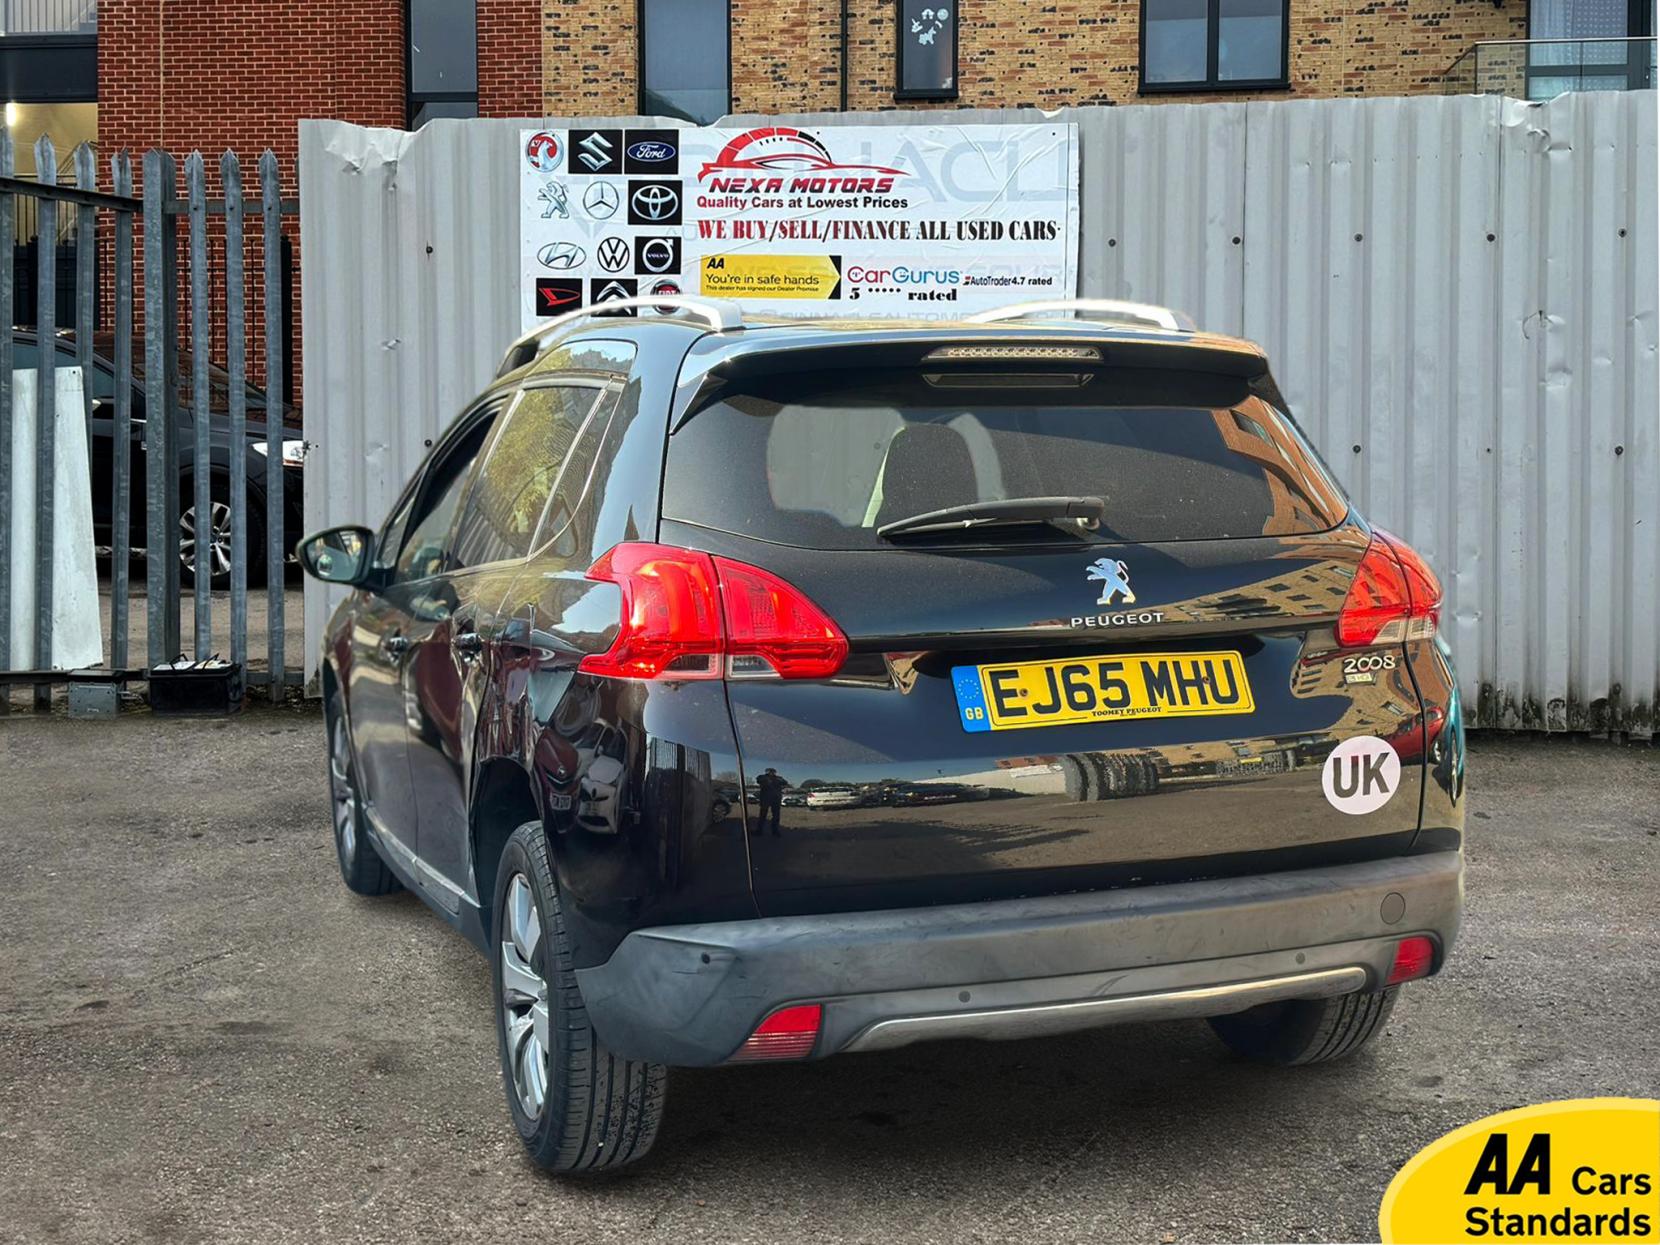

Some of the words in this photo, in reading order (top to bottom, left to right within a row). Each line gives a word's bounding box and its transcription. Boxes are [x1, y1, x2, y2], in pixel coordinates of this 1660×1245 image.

[636, 144, 666, 158] Ford
[709, 178, 784, 193] NEXA
[789, 178, 895, 193] MOTORS
[697, 196, 747, 210] Quality
[752, 197, 784, 208] Cars
[789, 198, 803, 208] at
[807, 197, 859, 208] Lowest
[863, 196, 909, 208] Prices
[697, 219, 727, 240] WE
[916, 221, 951, 241] ALL
[956, 221, 1004, 241] USED
[1009, 220, 1057, 241] CARS
[706, 257, 725, 269] AA
[705, 274, 741, 284] You're
[744, 274, 754, 284] in
[757, 274, 781, 285] safe
[784, 275, 820, 285] hands
[847, 265, 960, 284] CarGurus
[1028, 277, 1053, 286] rated
[849, 288, 861, 300] 5
[908, 288, 958, 301] rated
[1070, 612, 1165, 628] PEUGEOT
[1343, 654, 1396, 673] 2008
[988, 661, 1132, 718] EJ65
[1139, 658, 1240, 707] MHU
[965, 707, 985, 720] GB
[1091, 709, 1125, 717] TOOMEY
[1126, 706, 1163, 715] PEUGEOT
[1333, 752, 1390, 798] UK
